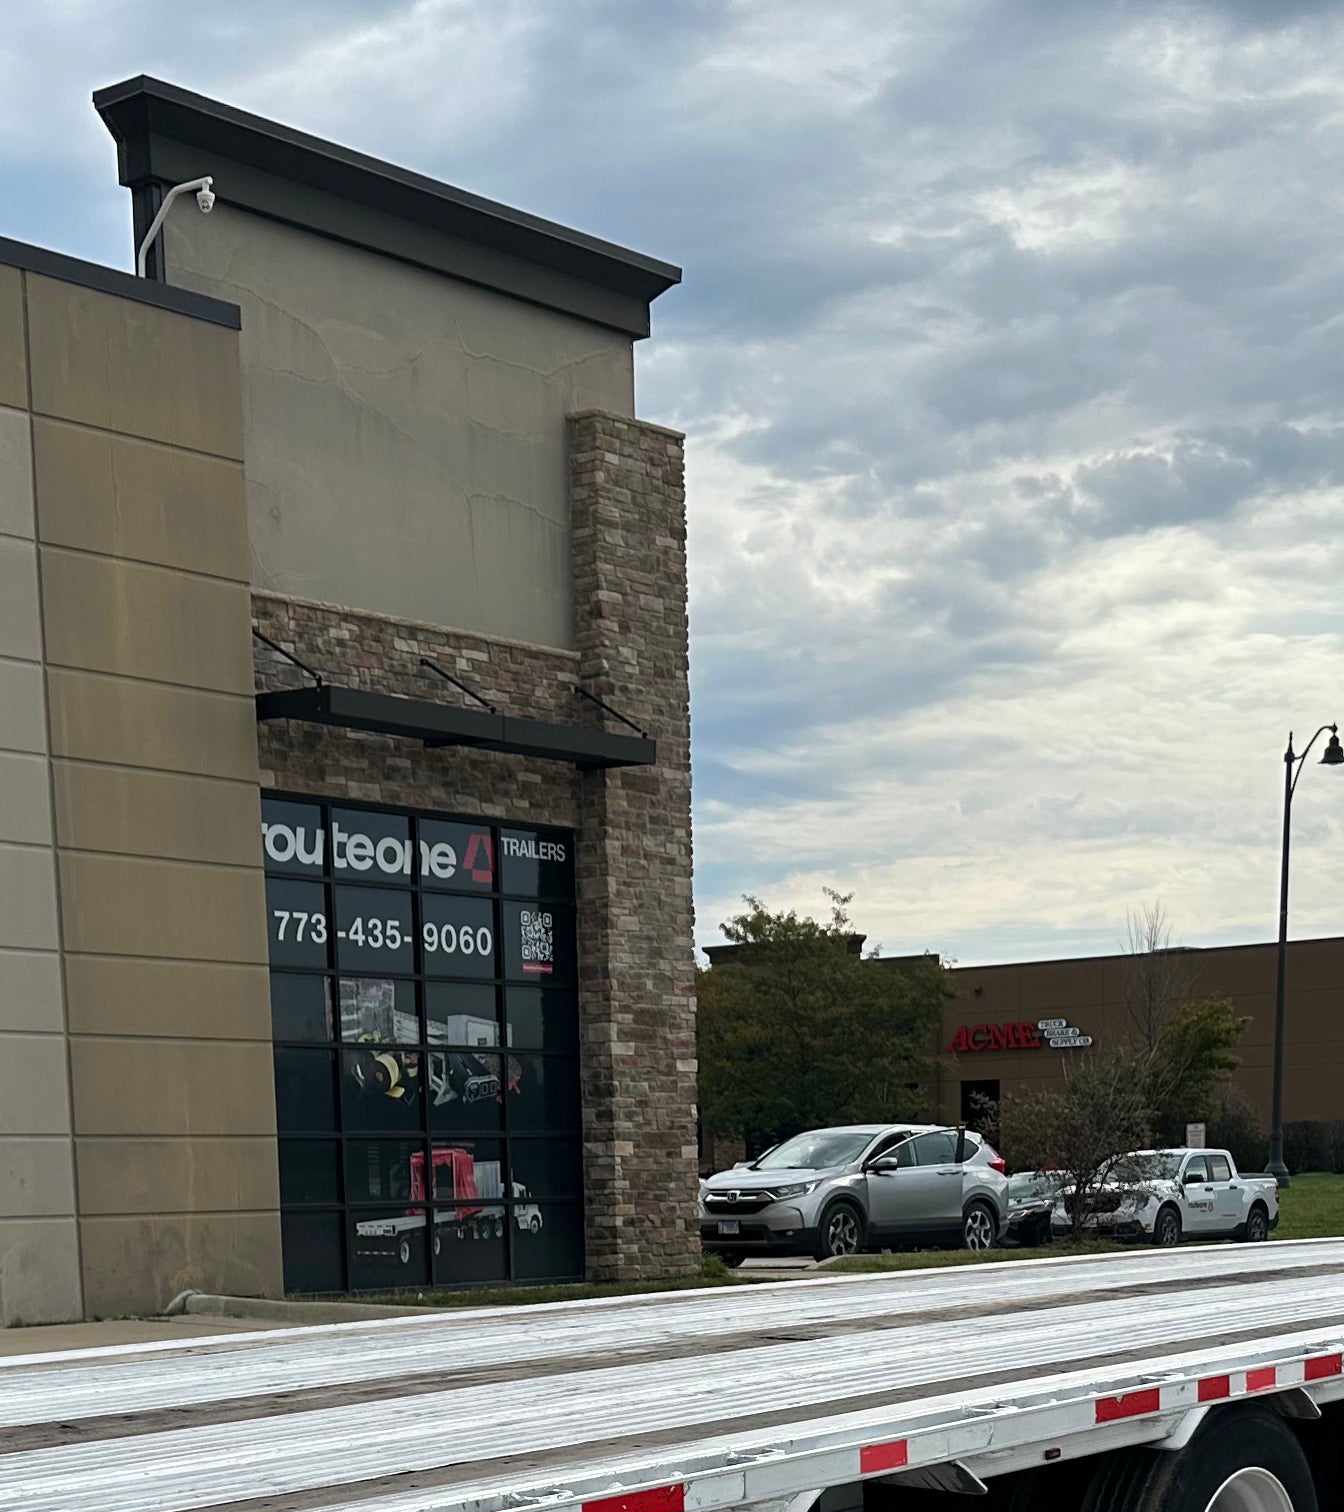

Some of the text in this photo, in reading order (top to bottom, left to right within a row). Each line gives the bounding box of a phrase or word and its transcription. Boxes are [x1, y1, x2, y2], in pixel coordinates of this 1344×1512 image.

[500, 836, 566, 862] TRAILERS
[1040, 1020, 1064, 1028] TRUCK
[946, 1021, 1041, 1052] ACME
[1051, 1038, 1078, 1046] SUPPLY
